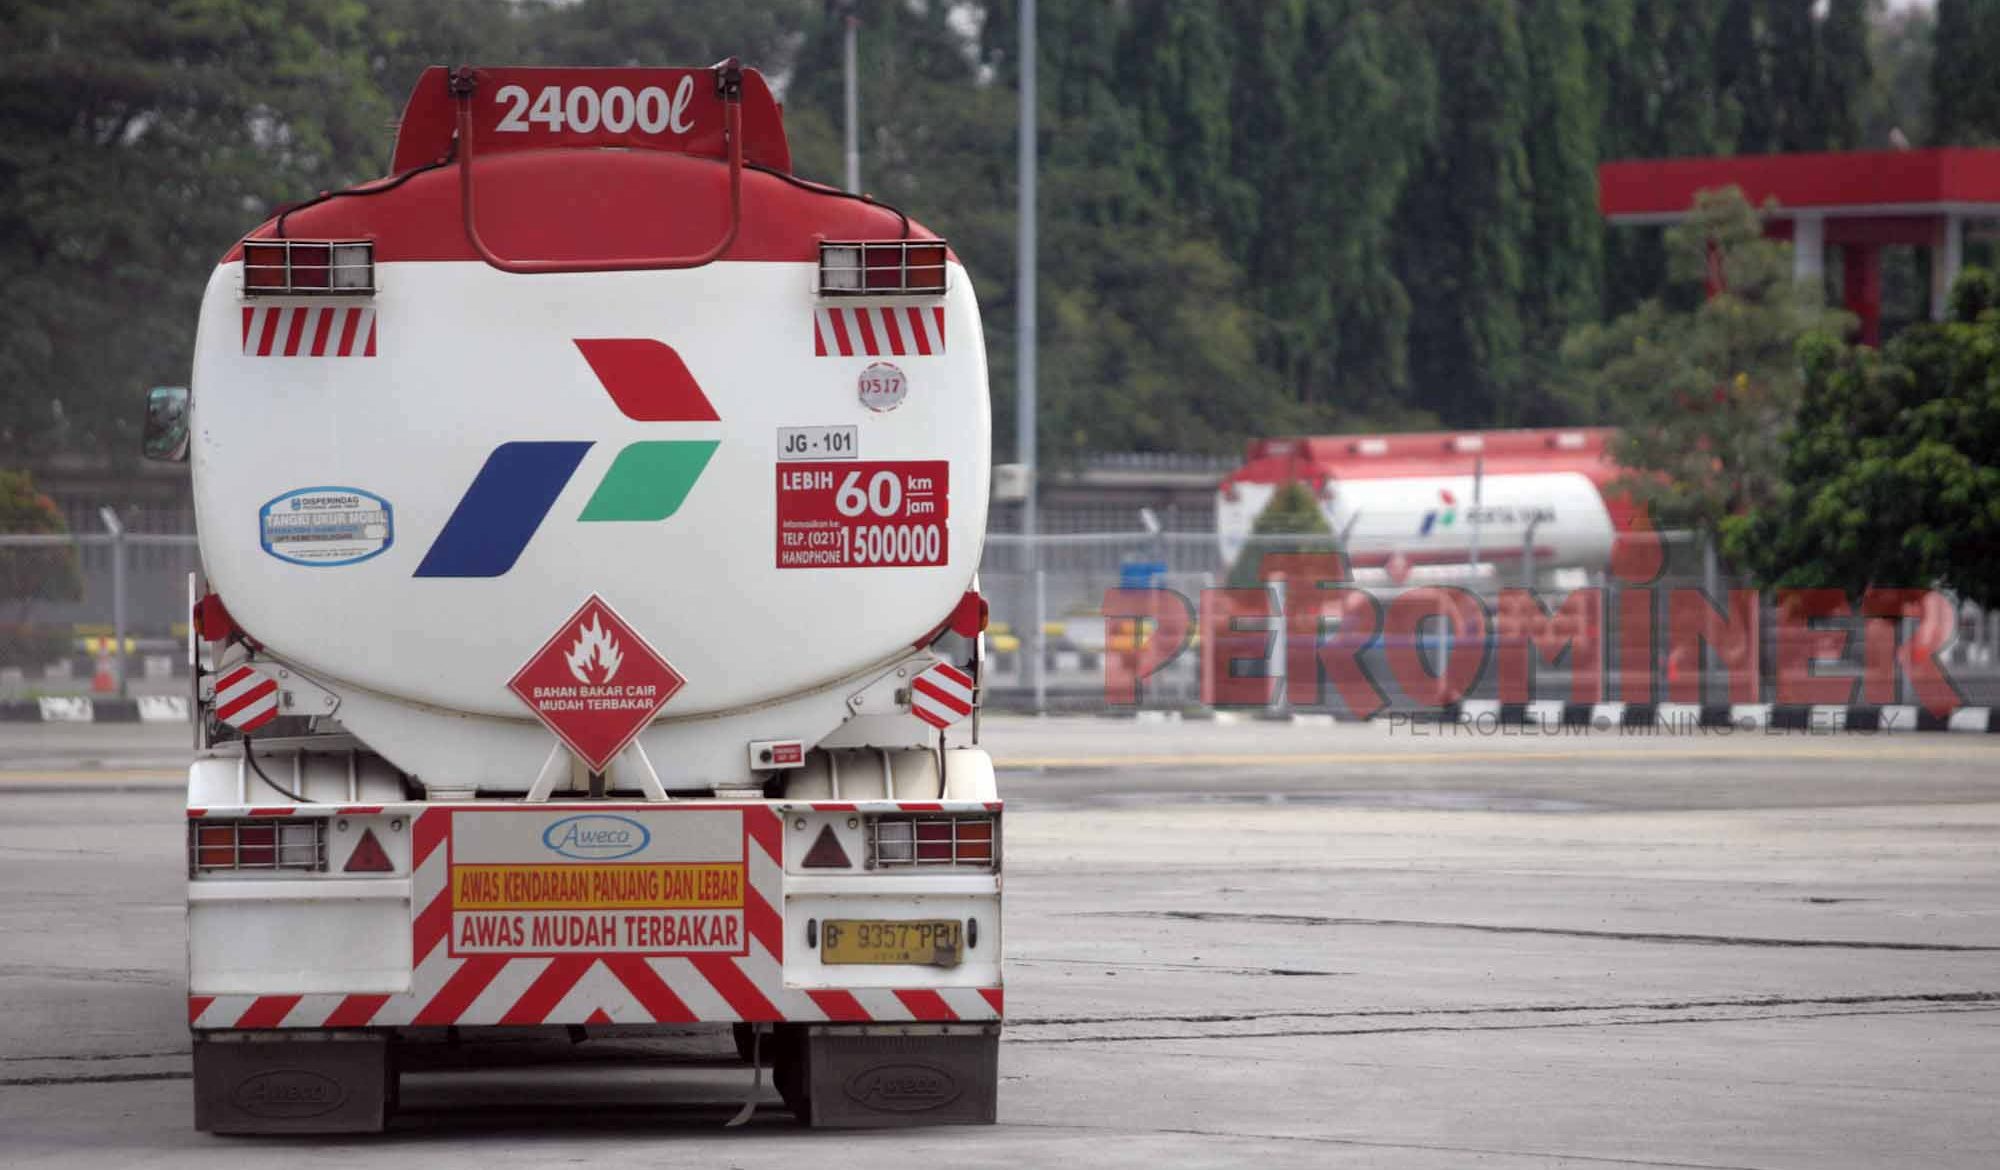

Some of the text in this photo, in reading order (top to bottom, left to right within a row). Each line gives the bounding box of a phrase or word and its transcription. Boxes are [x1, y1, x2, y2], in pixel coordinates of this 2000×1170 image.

[494, 74, 696, 134] 24000l
[785, 435, 808, 453] JG
[823, 432, 852, 451] 101
[782, 470, 933, 517] LEBIH 60 km
[905, 498, 935, 517] jam
[782, 524, 940, 564] TELP. (021) 1500000
[781, 550, 841, 564] HANDPHONE
[534, 685, 656, 697] BAHAN BAKAR CAIR
[540, 698, 653, 710] MUDAH TERBAKAR
[559, 822, 632, 848] Aweco
[460, 869, 738, 901] AWAS KENDARAAN PANJANG DAN LEBAR
[460, 915, 738, 946] AWAS MUDAH TERBAKAR
[857, 924, 909, 949] 9357
